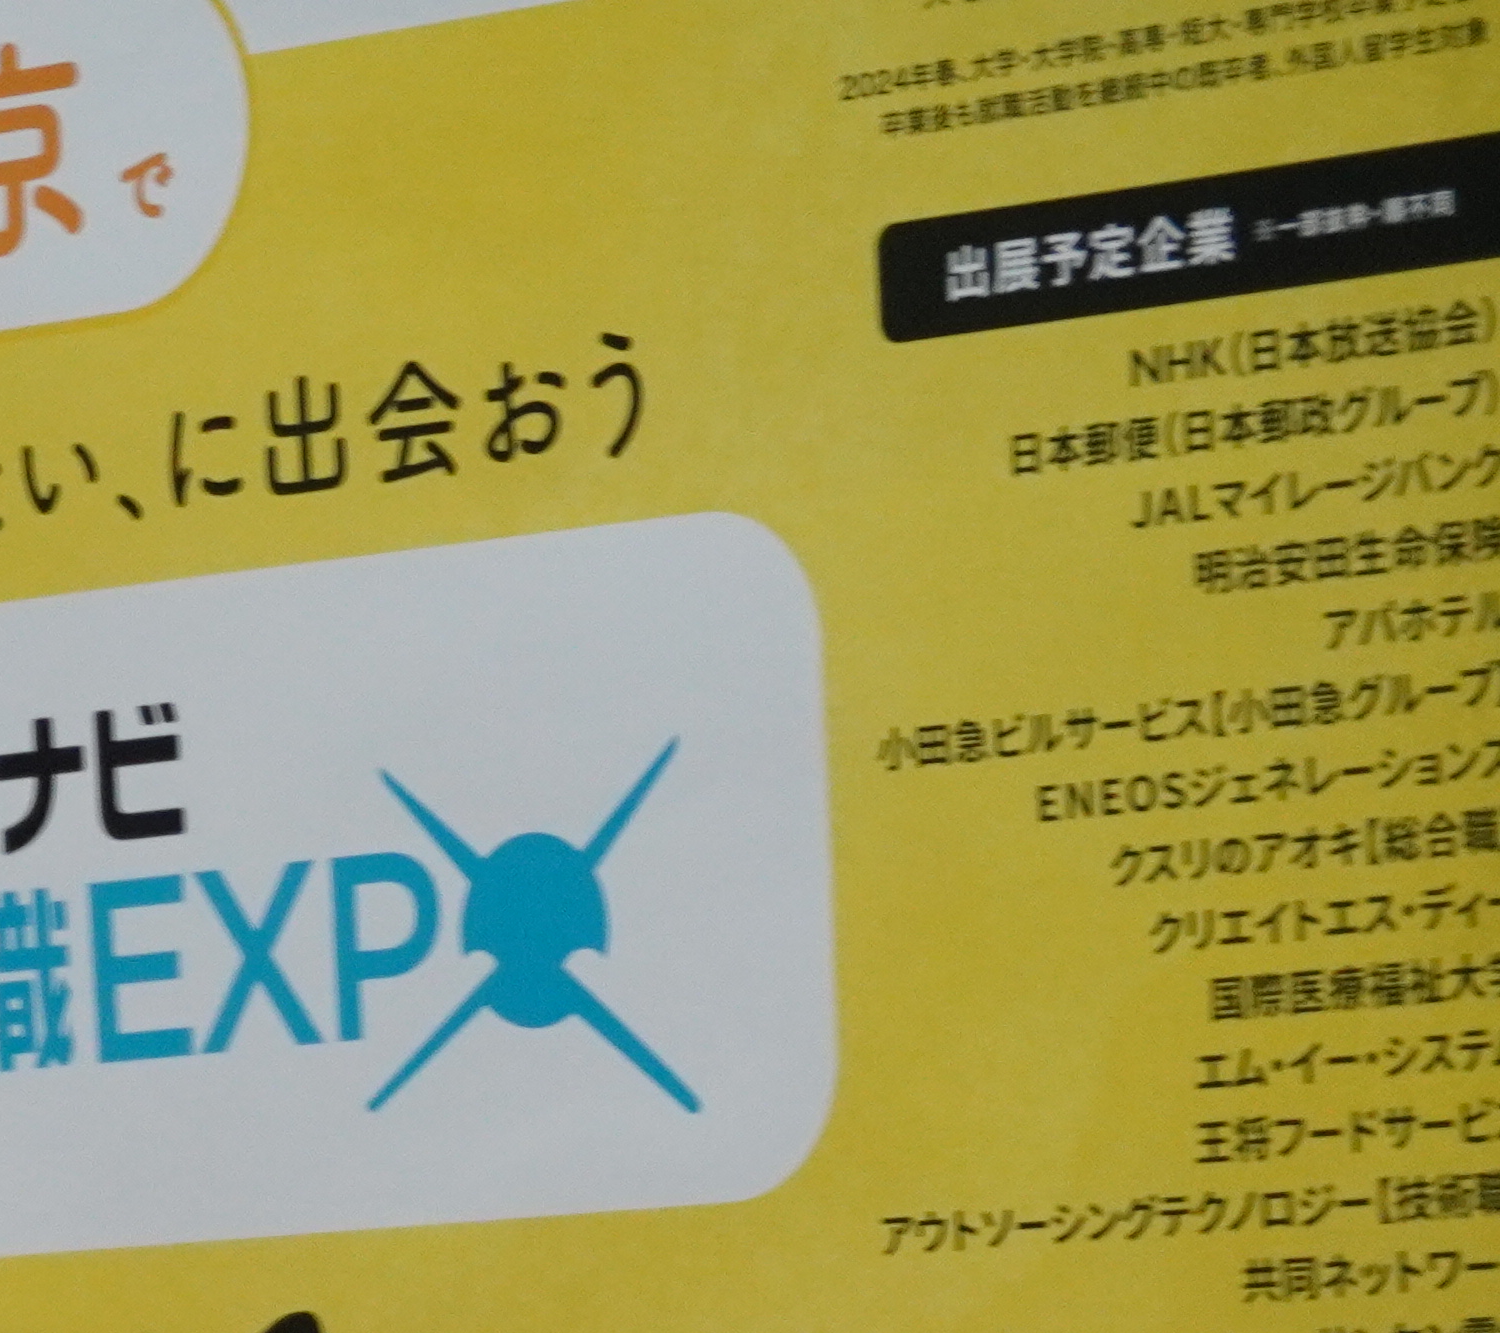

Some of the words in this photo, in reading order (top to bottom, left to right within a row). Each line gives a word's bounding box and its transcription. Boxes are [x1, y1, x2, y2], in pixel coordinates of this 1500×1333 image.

[945, 207, 1236, 301] 出展予定企業
[1126, 298, 1499, 387] NHK(日本放送協会)
[1011, 368, 1499, 476] 日本郵便(日本郵政グループ)
[1196, 1029, 1500, 1089] エム・イー・システ
